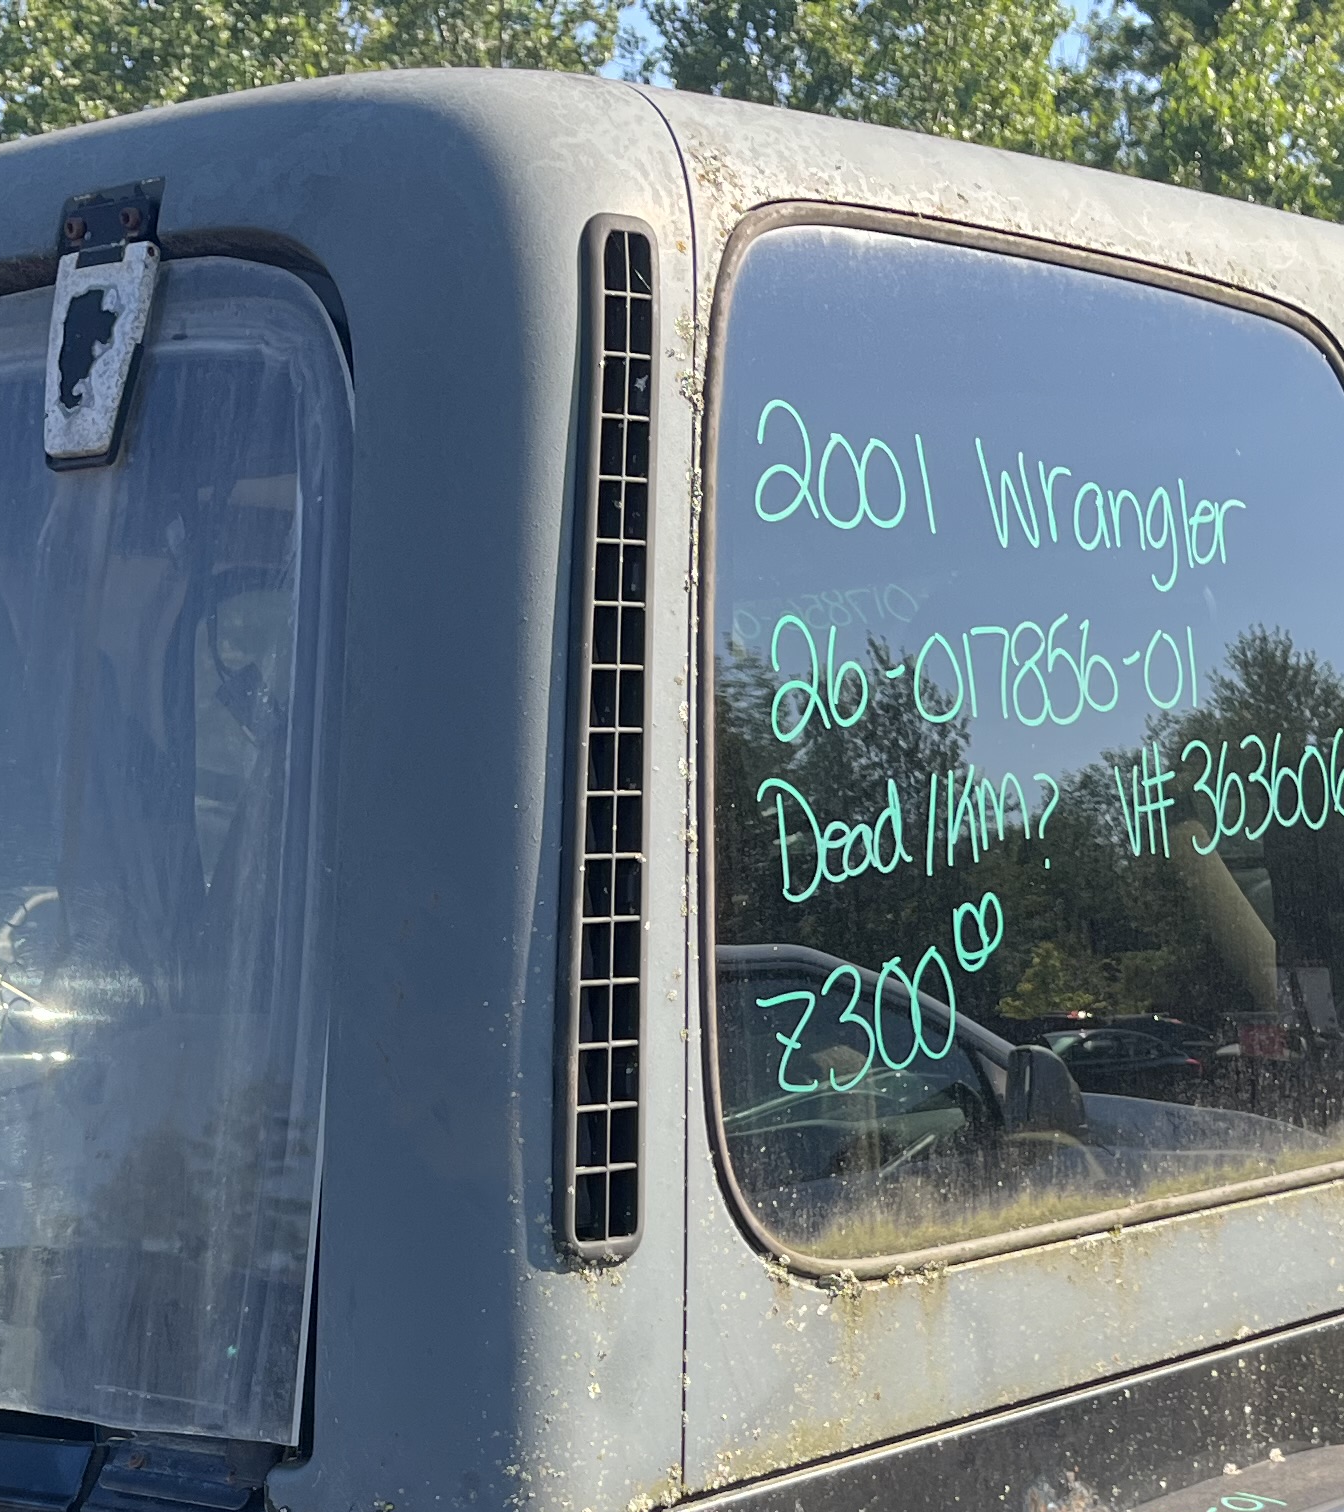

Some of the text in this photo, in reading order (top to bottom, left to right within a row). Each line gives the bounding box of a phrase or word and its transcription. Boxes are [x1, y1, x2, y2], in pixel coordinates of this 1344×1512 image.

[755, 399, 1246, 591] 2001 Wrangler
[771, 612, 1198, 743] 26-017856-01
